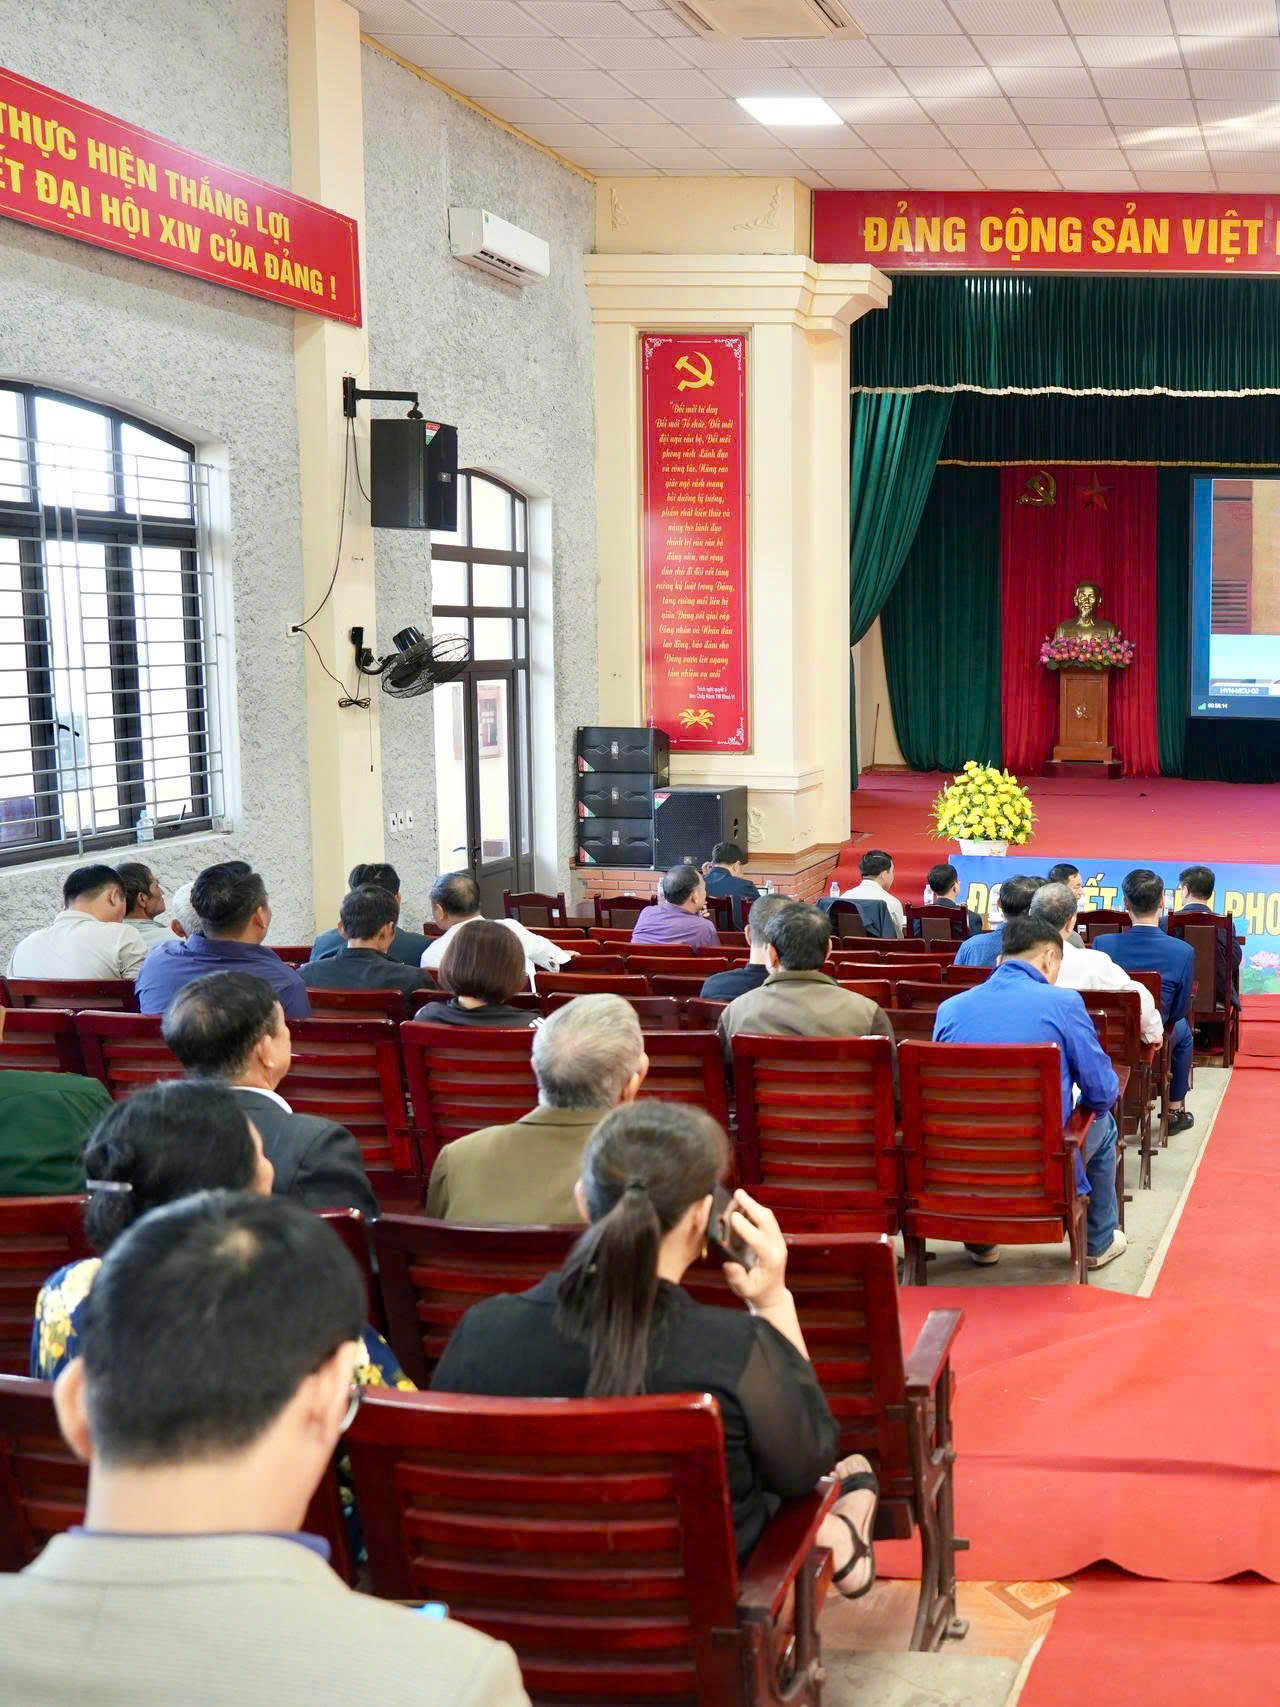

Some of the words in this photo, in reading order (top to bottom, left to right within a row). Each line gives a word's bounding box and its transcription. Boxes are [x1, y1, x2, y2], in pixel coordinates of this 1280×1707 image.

[35, 168, 91, 219] ĐẠI
[101, 192, 150, 240] HỘI
[159, 214, 201, 254] XIV
[209, 228, 259, 275] CỦA
[264, 248, 323, 297] ĐẢNG
[88, 137, 157, 193] HIỆN
[165, 169, 249, 228] THẮNG
[256, 205, 291, 244] LỢI
[864, 201, 966, 253] ĐẢNG
[980, 207, 1082, 261] CỘNG
[1092, 202, 1170, 254] SẢN
[1182, 210, 1263, 263] VIỆT
